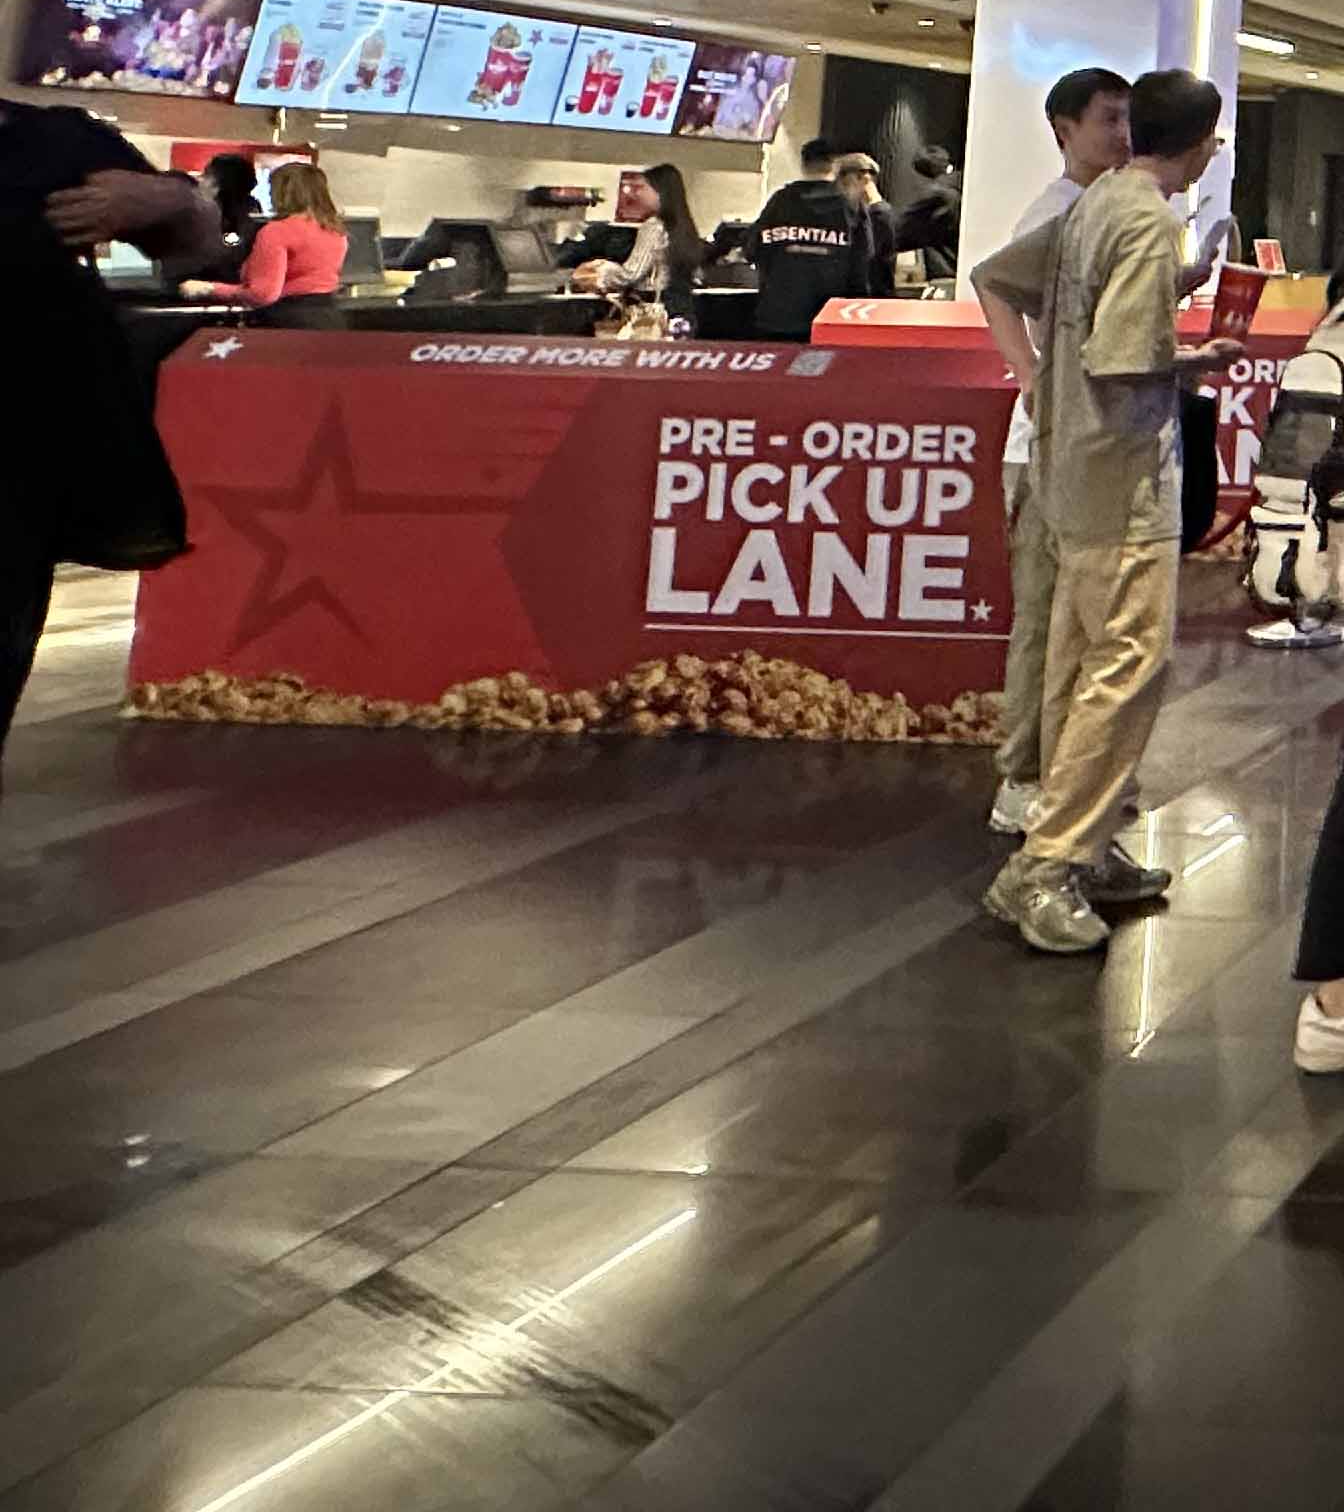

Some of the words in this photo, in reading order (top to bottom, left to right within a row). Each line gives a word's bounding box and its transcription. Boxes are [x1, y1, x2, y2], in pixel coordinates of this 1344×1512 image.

[410, 343, 528, 364] ORDER
[530, 347, 629, 368] MORE
[635, 350, 726, 371] WITH
[728, 352, 777, 371] US
[659, 417, 756, 456] PRE
[802, 420, 977, 463] ORDER
[653, 461, 843, 525] PICK
[865, 467, 975, 527] UP
[646, 526, 970, 622] LANE
